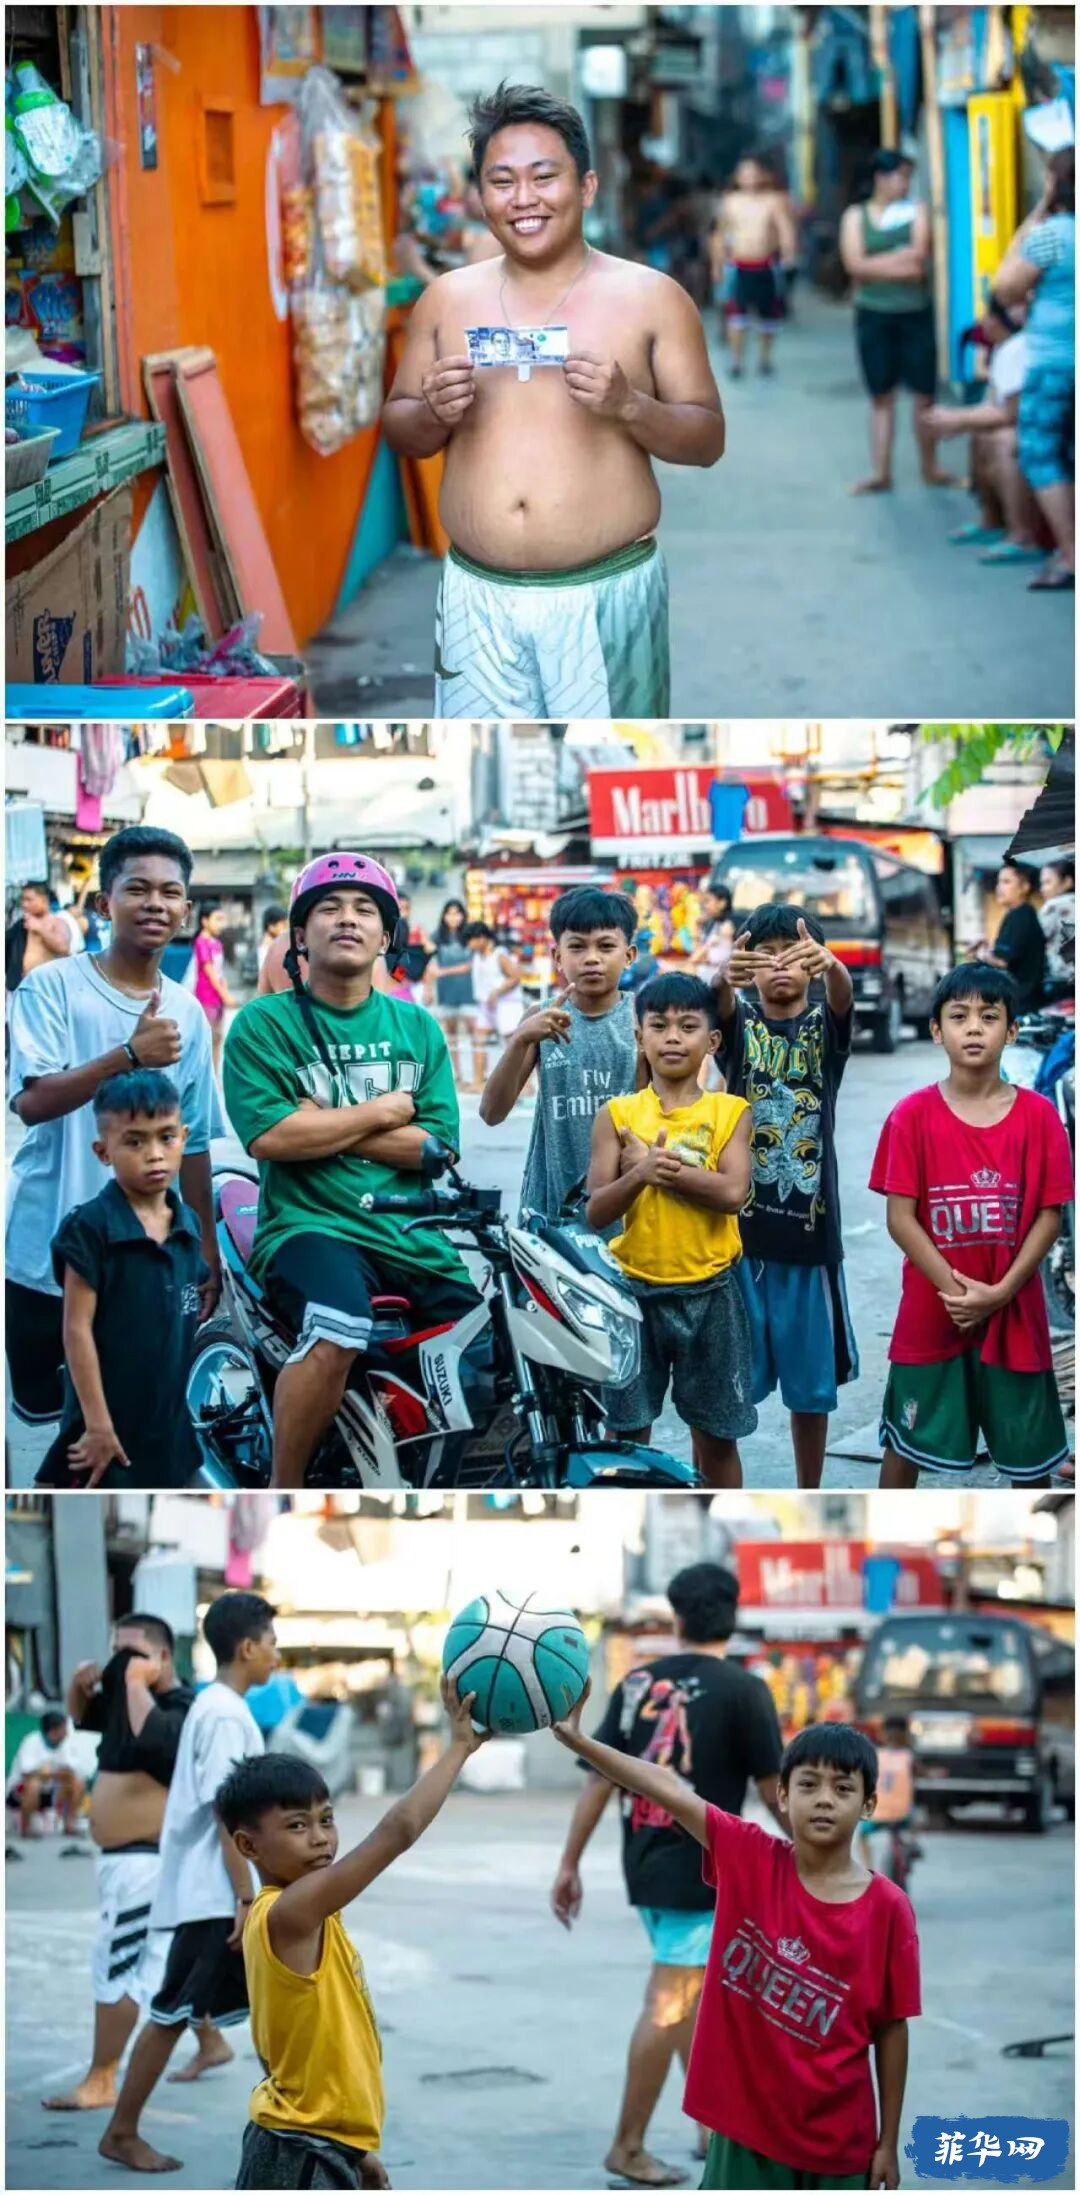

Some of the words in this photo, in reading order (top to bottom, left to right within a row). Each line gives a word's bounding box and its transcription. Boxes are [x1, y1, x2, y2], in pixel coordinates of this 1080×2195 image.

[611, 779, 768, 836] Marlbo
[582, 1069, 611, 1089] Fly
[433, 1353, 452, 1407] SUZUKI
[760, 1544, 920, 1606] Marlbo
[722, 1937, 841, 2037] QUEEN
